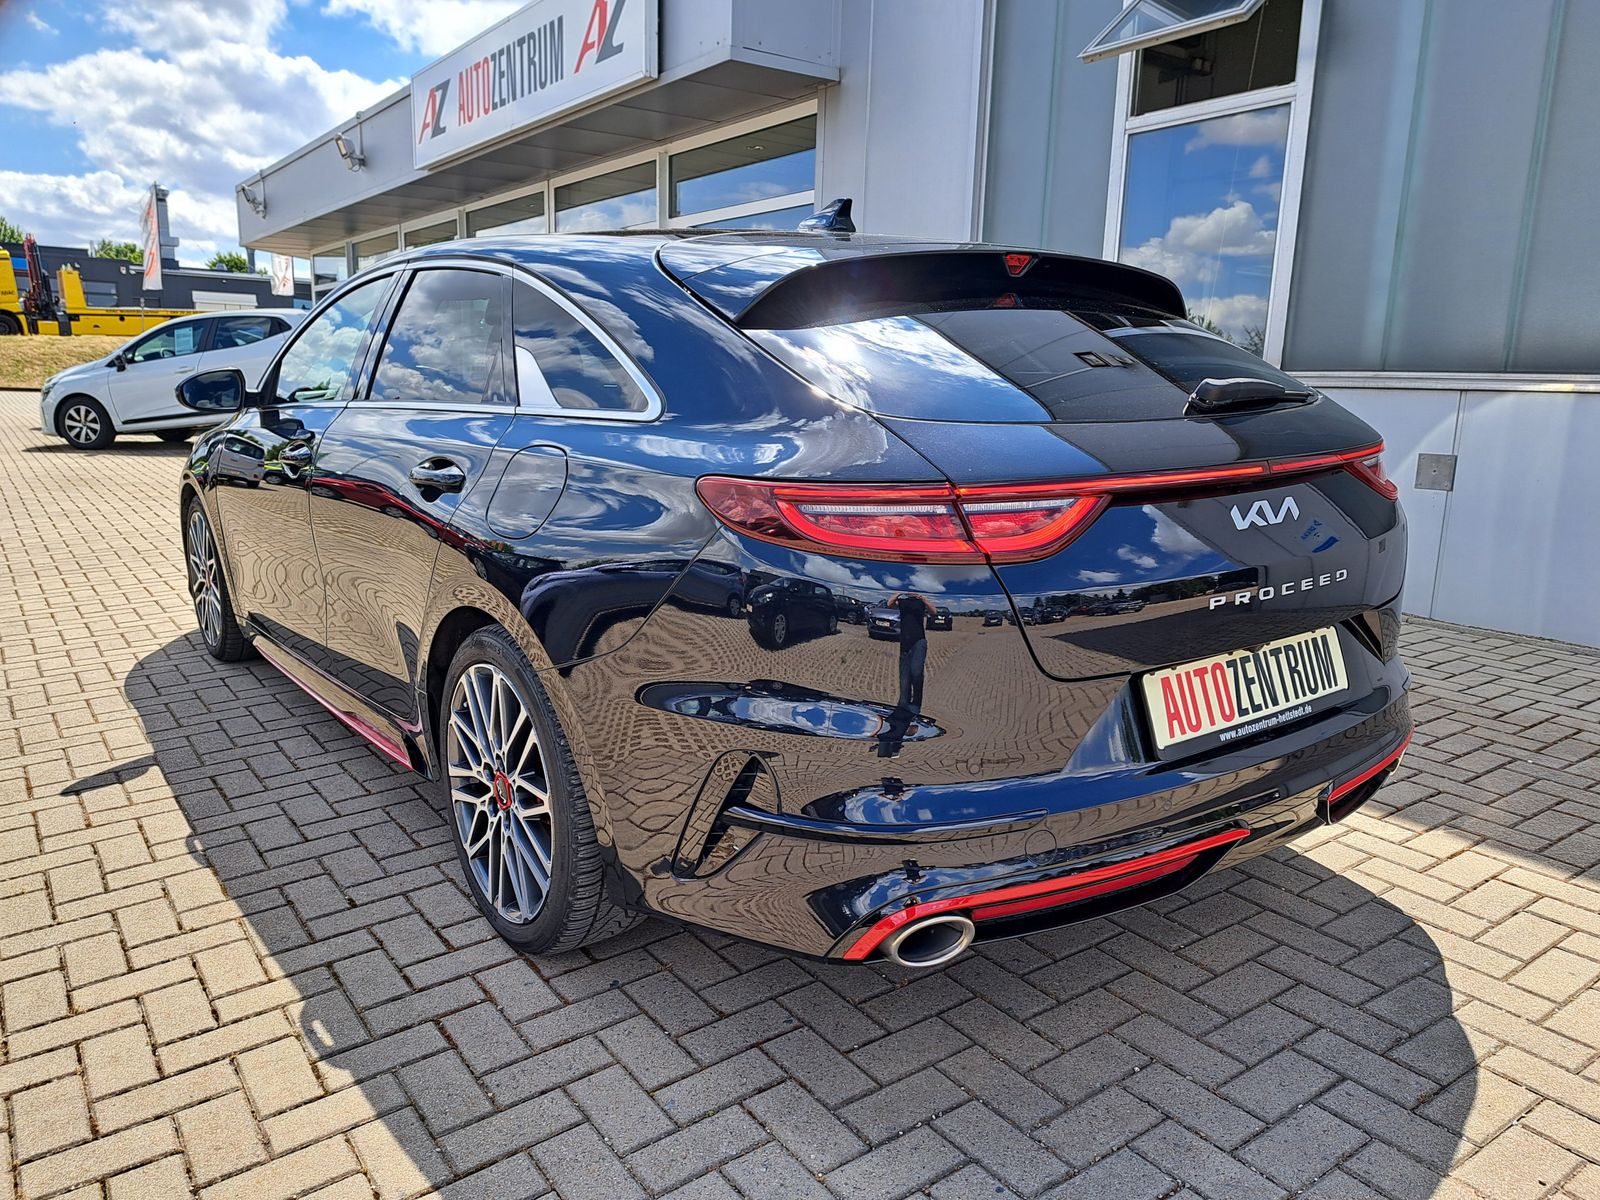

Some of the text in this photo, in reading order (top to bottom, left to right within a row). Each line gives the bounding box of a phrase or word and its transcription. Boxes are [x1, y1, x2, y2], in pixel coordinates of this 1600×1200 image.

[418, 78, 451, 145] AZ
[458, 16, 564, 127] AUTOZENTRUM
[1230, 496, 1300, 531] KIA
[1208, 568, 1348, 611] PROCEED
[1160, 634, 1339, 739] AUTOZENTRUM
[1219, 705, 1312, 742] www.autozentrum-hettstedt.de
